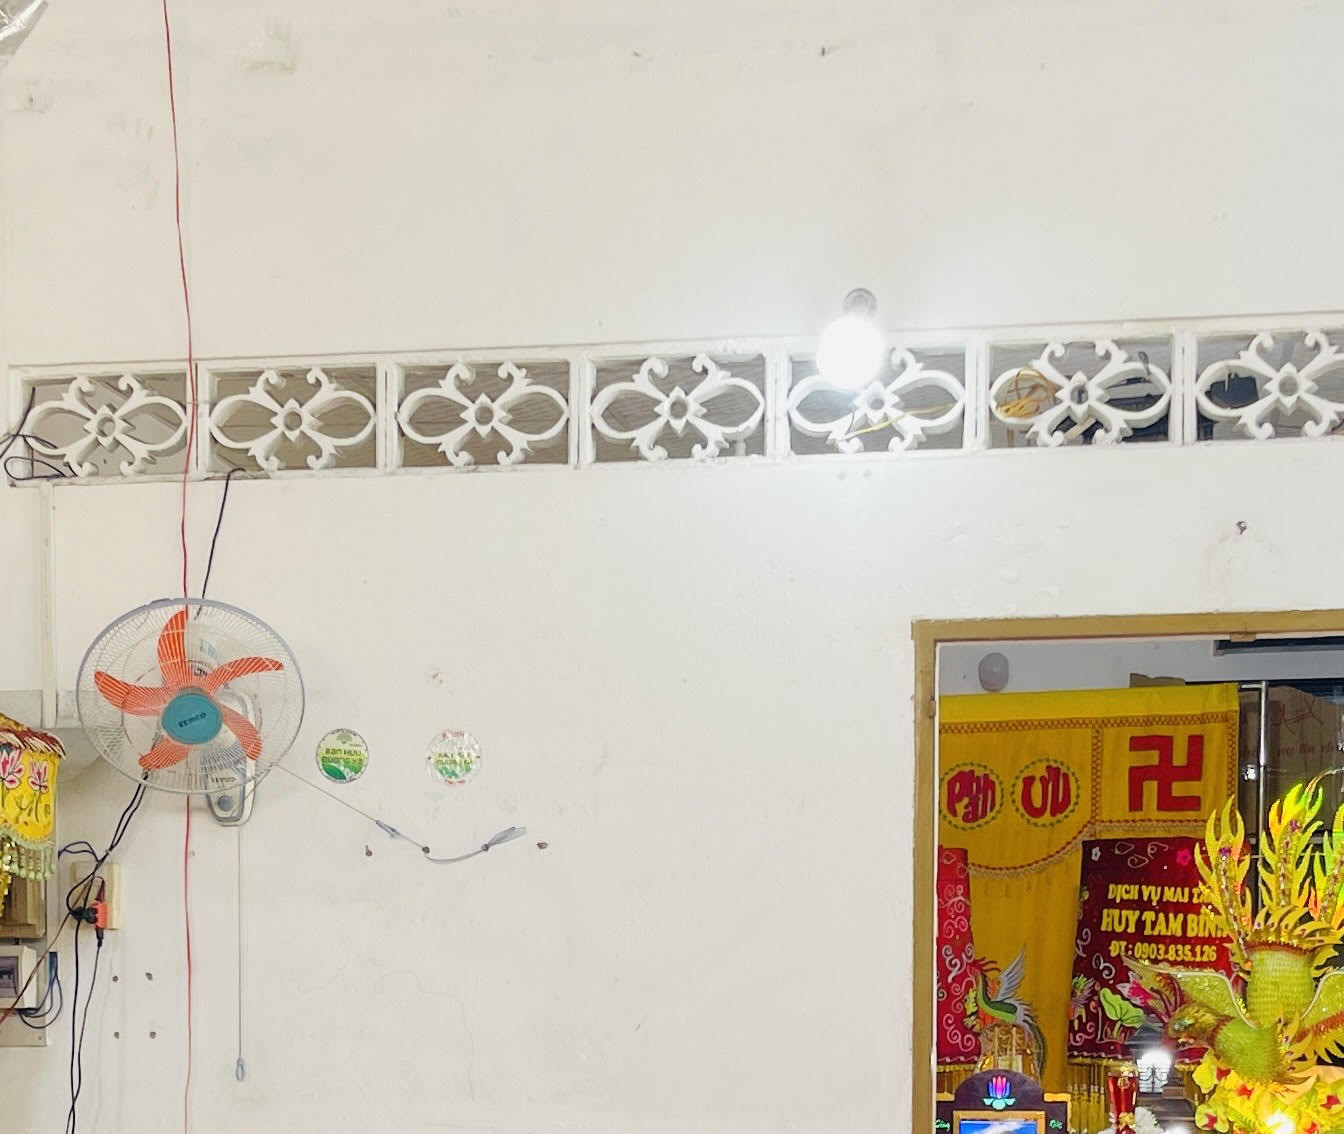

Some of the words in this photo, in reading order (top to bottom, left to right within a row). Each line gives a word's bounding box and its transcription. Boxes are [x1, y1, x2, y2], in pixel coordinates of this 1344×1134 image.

[1108, 884, 1139, 903] DỊCH
[1141, 885, 1161, 906] VỤ
[1163, 886, 1189, 903] MAI
[1101, 908, 1140, 934] HUY
[1142, 910, 1184, 938] TAM
